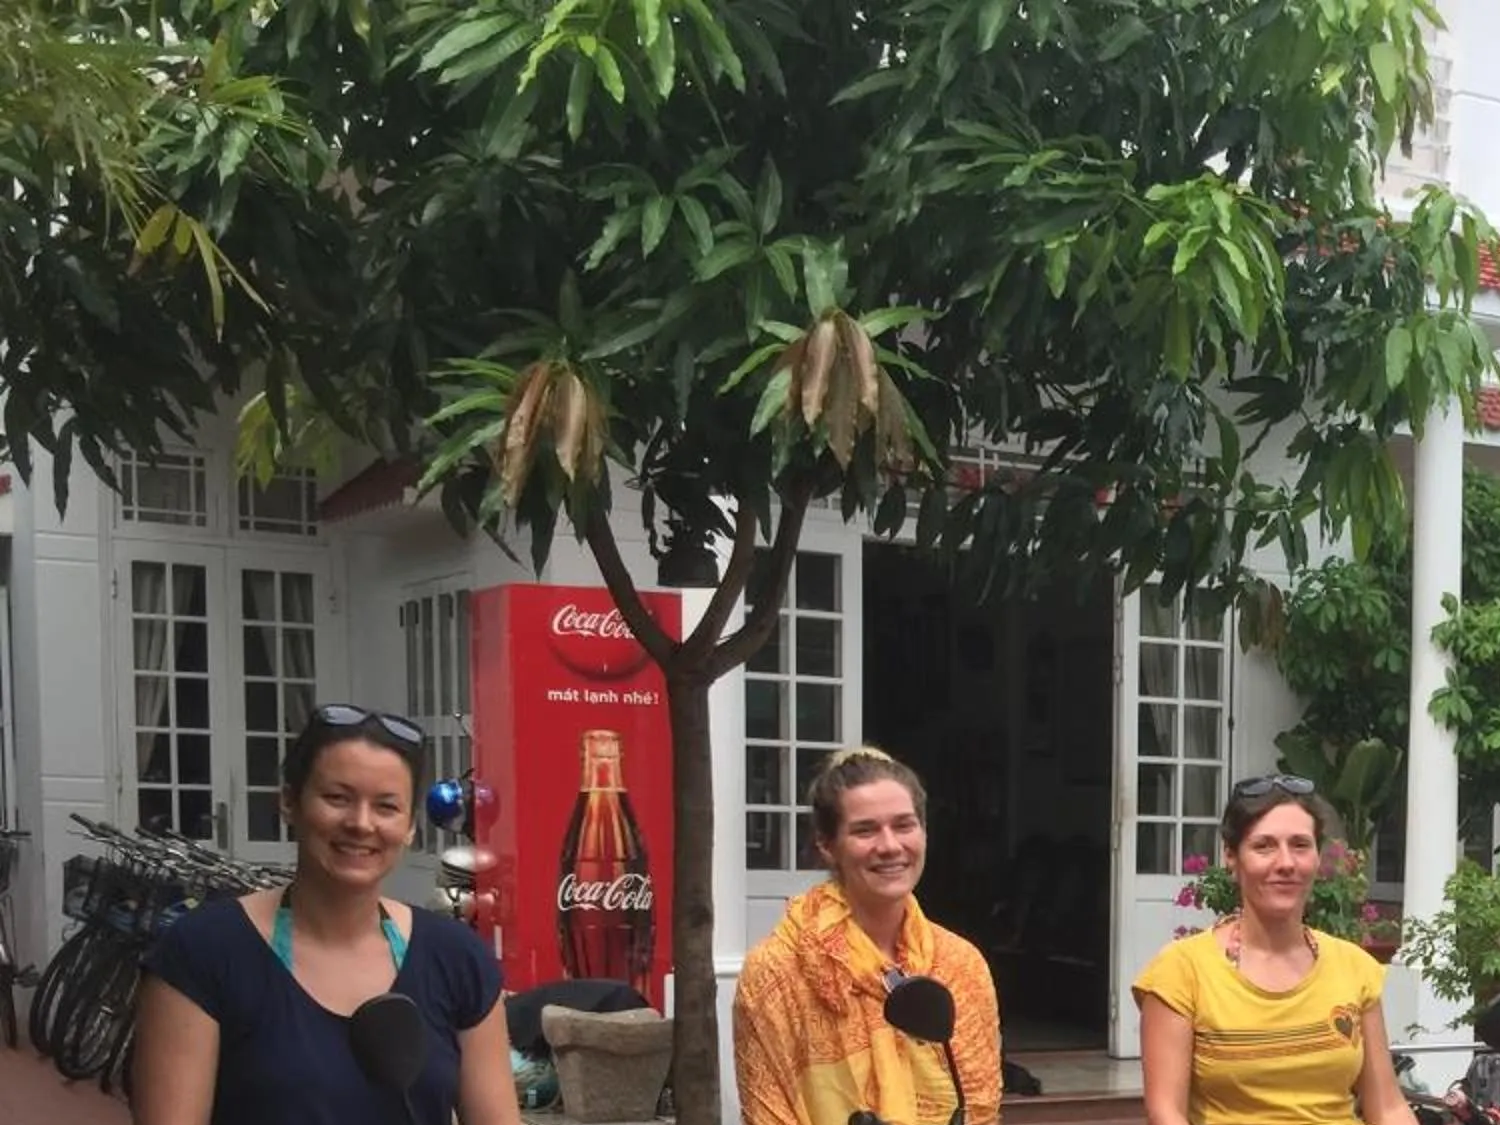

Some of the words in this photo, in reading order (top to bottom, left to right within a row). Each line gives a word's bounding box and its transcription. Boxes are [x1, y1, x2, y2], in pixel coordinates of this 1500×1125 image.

[547, 687, 579, 702] mát
[584, 689, 619, 705] lạnh
[623, 690, 660, 705] nhé!
[557, 873, 654, 911] Coca-Cola
